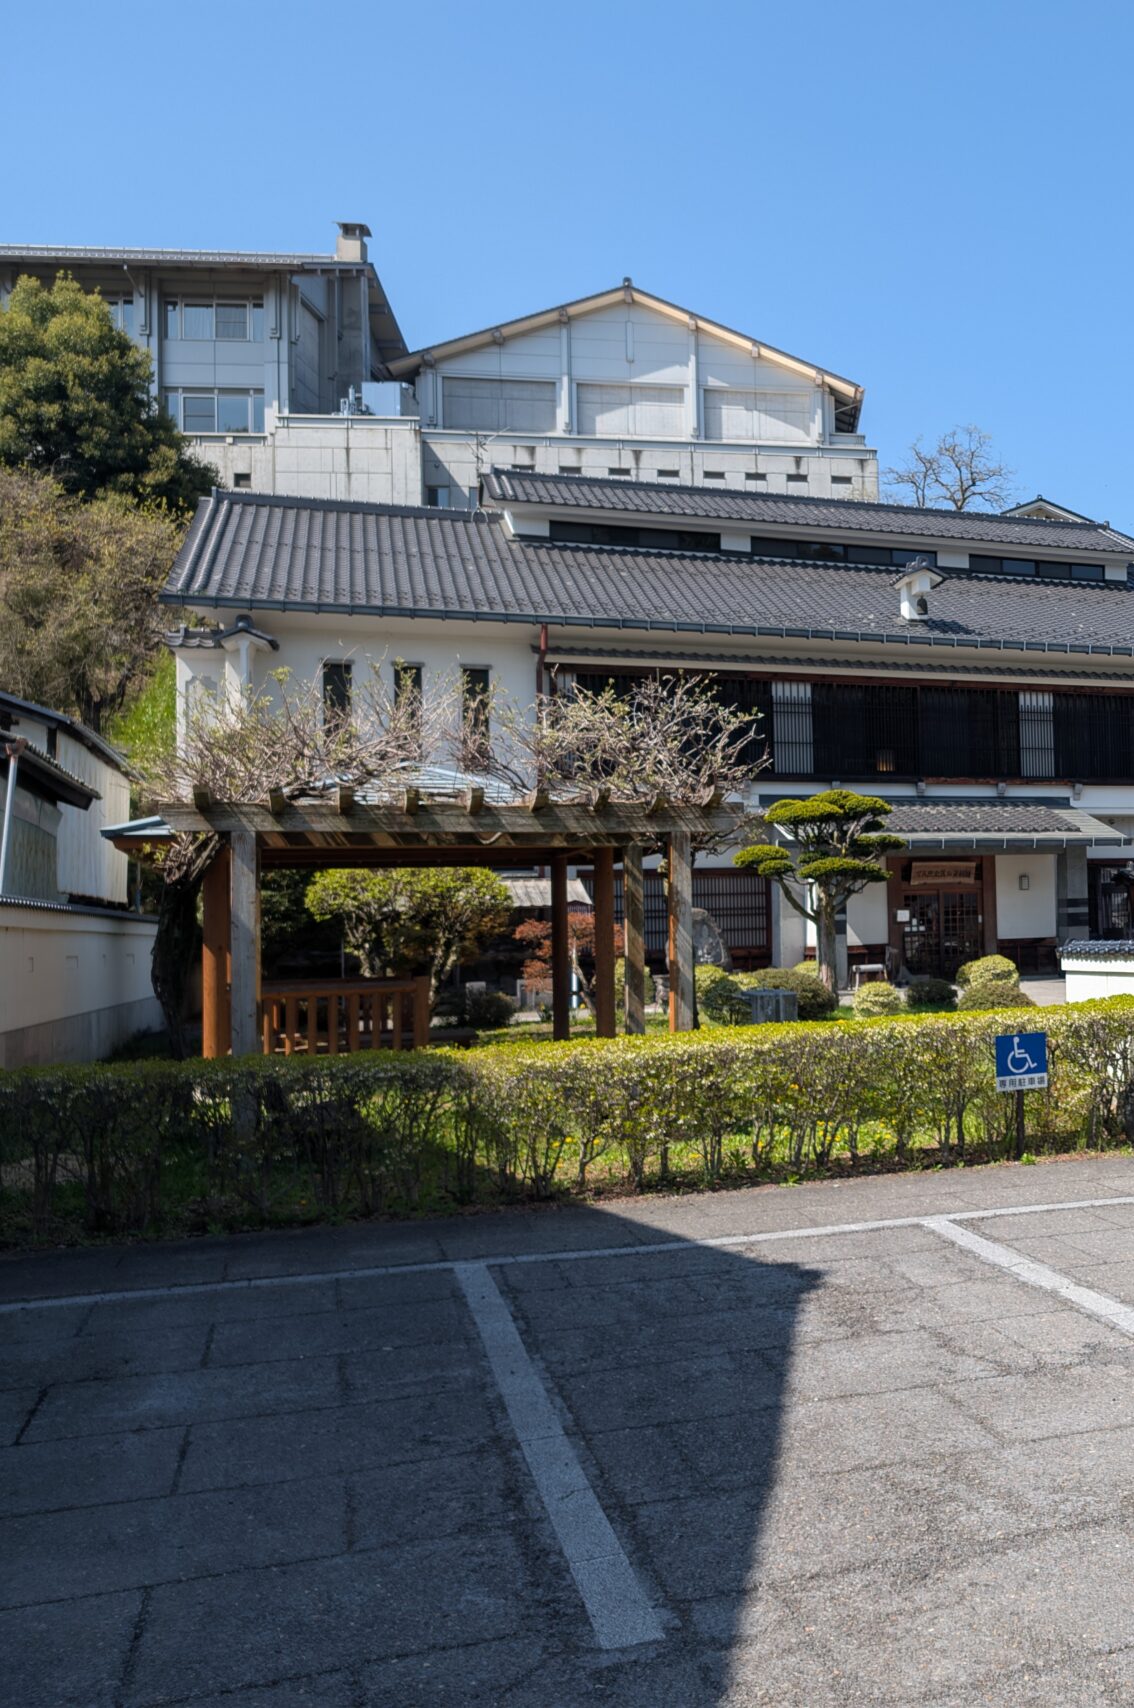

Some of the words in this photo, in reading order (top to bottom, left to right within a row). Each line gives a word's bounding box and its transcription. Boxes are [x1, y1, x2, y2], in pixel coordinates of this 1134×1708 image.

[999, 1075, 1046, 1088] 専用駐車場
